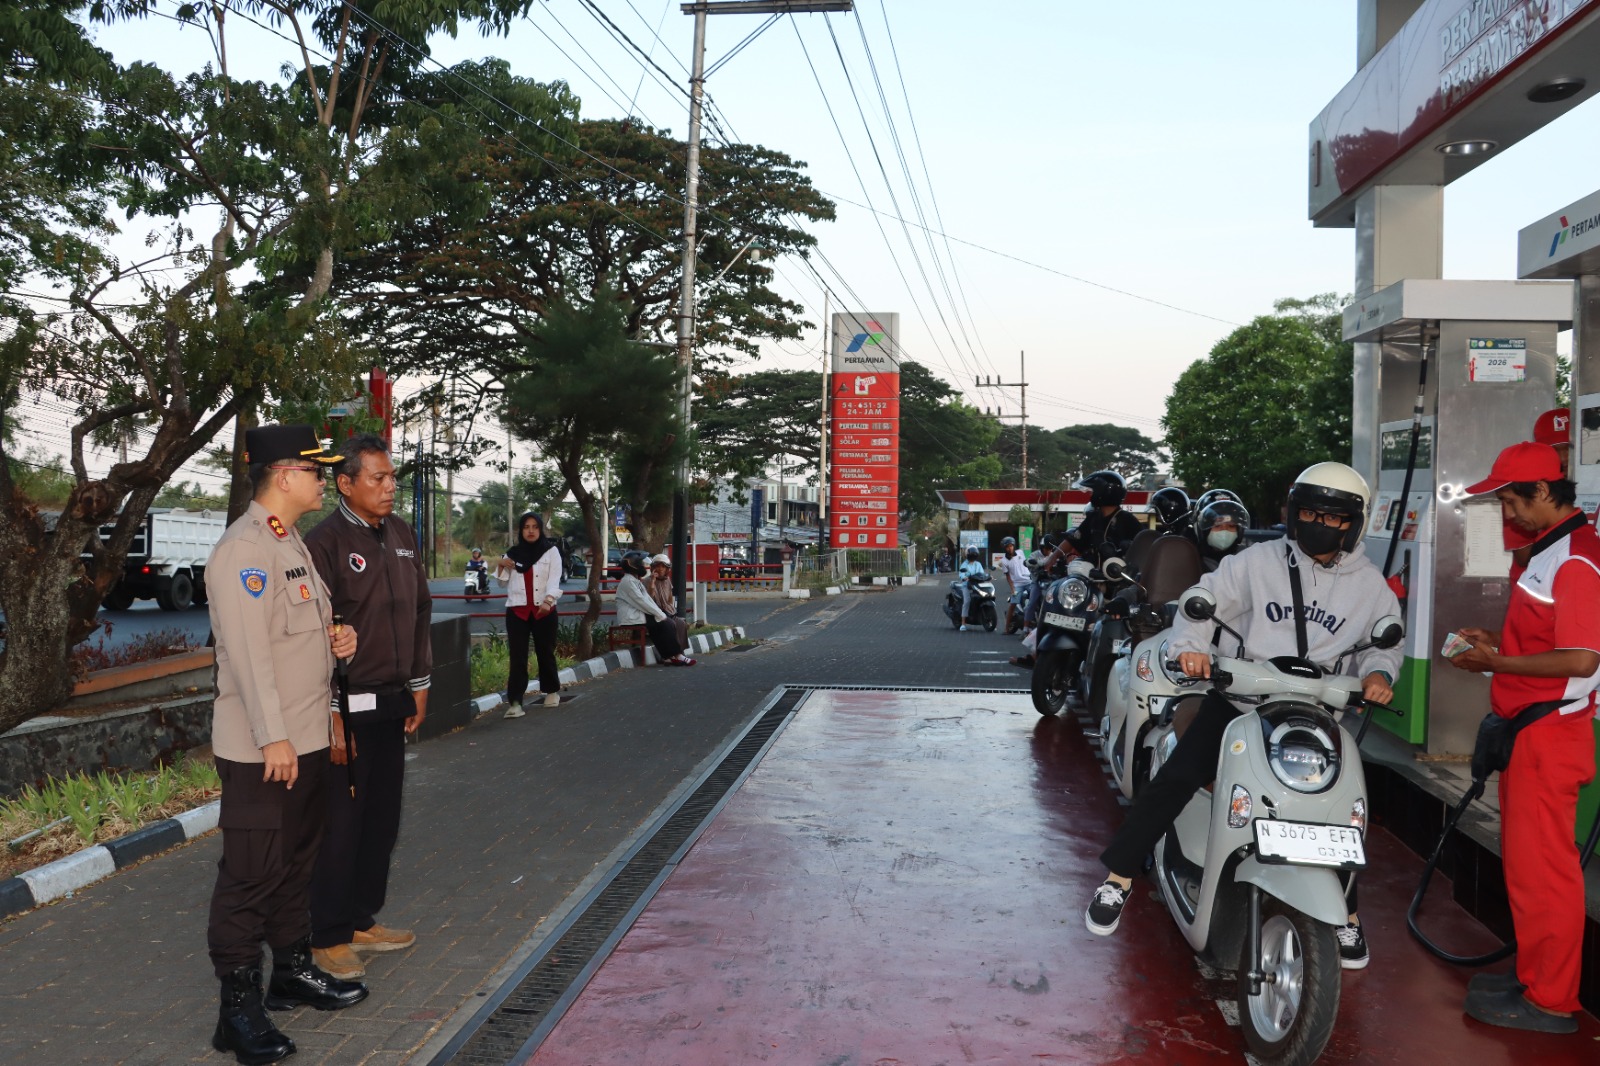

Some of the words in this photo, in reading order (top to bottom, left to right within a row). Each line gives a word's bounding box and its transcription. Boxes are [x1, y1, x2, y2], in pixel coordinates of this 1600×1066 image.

[1151, 697, 1159, 705] N
[1261, 823, 1270, 836] N
[1279, 824, 1317, 841] 3675
[1329, 829, 1358, 844] EFT
